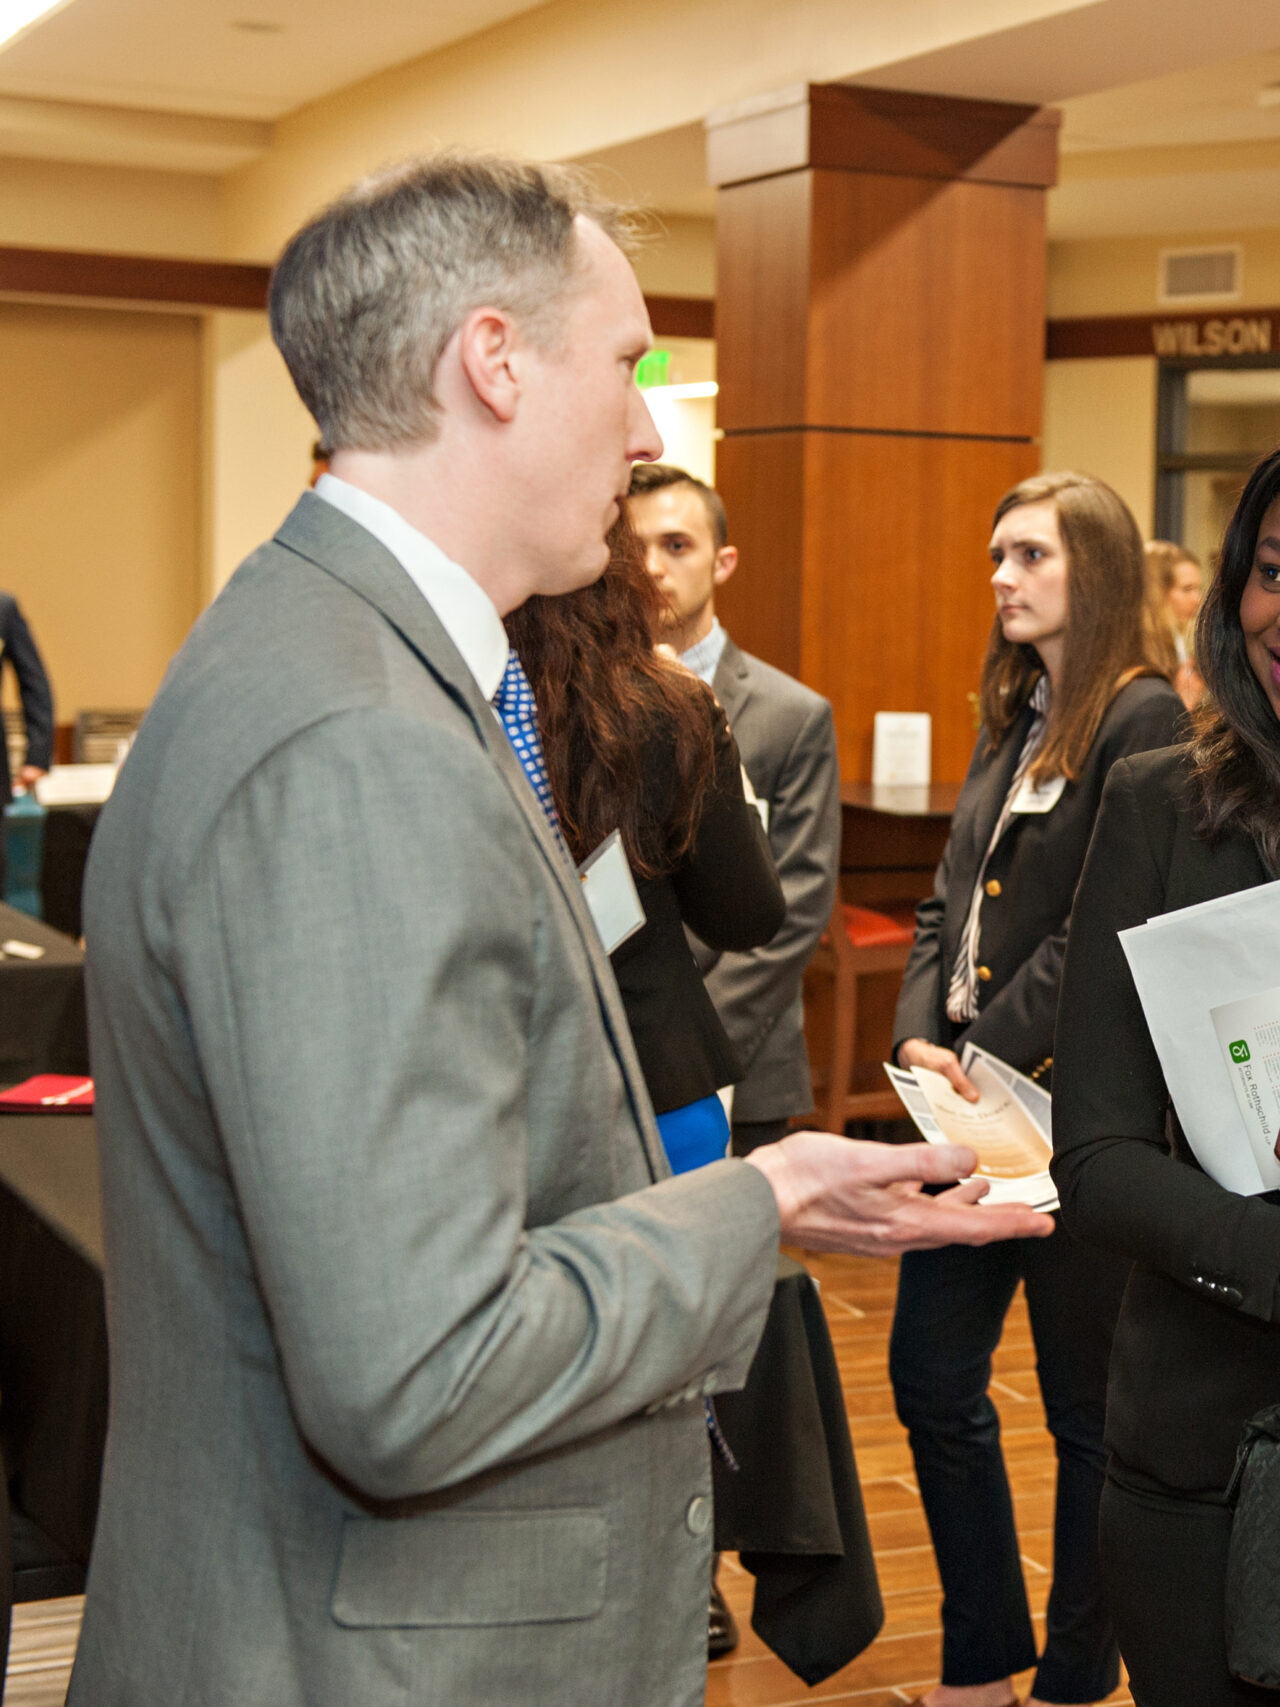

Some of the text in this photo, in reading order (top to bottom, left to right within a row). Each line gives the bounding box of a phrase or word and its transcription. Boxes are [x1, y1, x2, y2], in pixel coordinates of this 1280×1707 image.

[1153, 318, 1271, 356] WILSON
[1244, 1064, 1253, 1081] Fox
[1250, 1084, 1271, 1134] Rothschild
